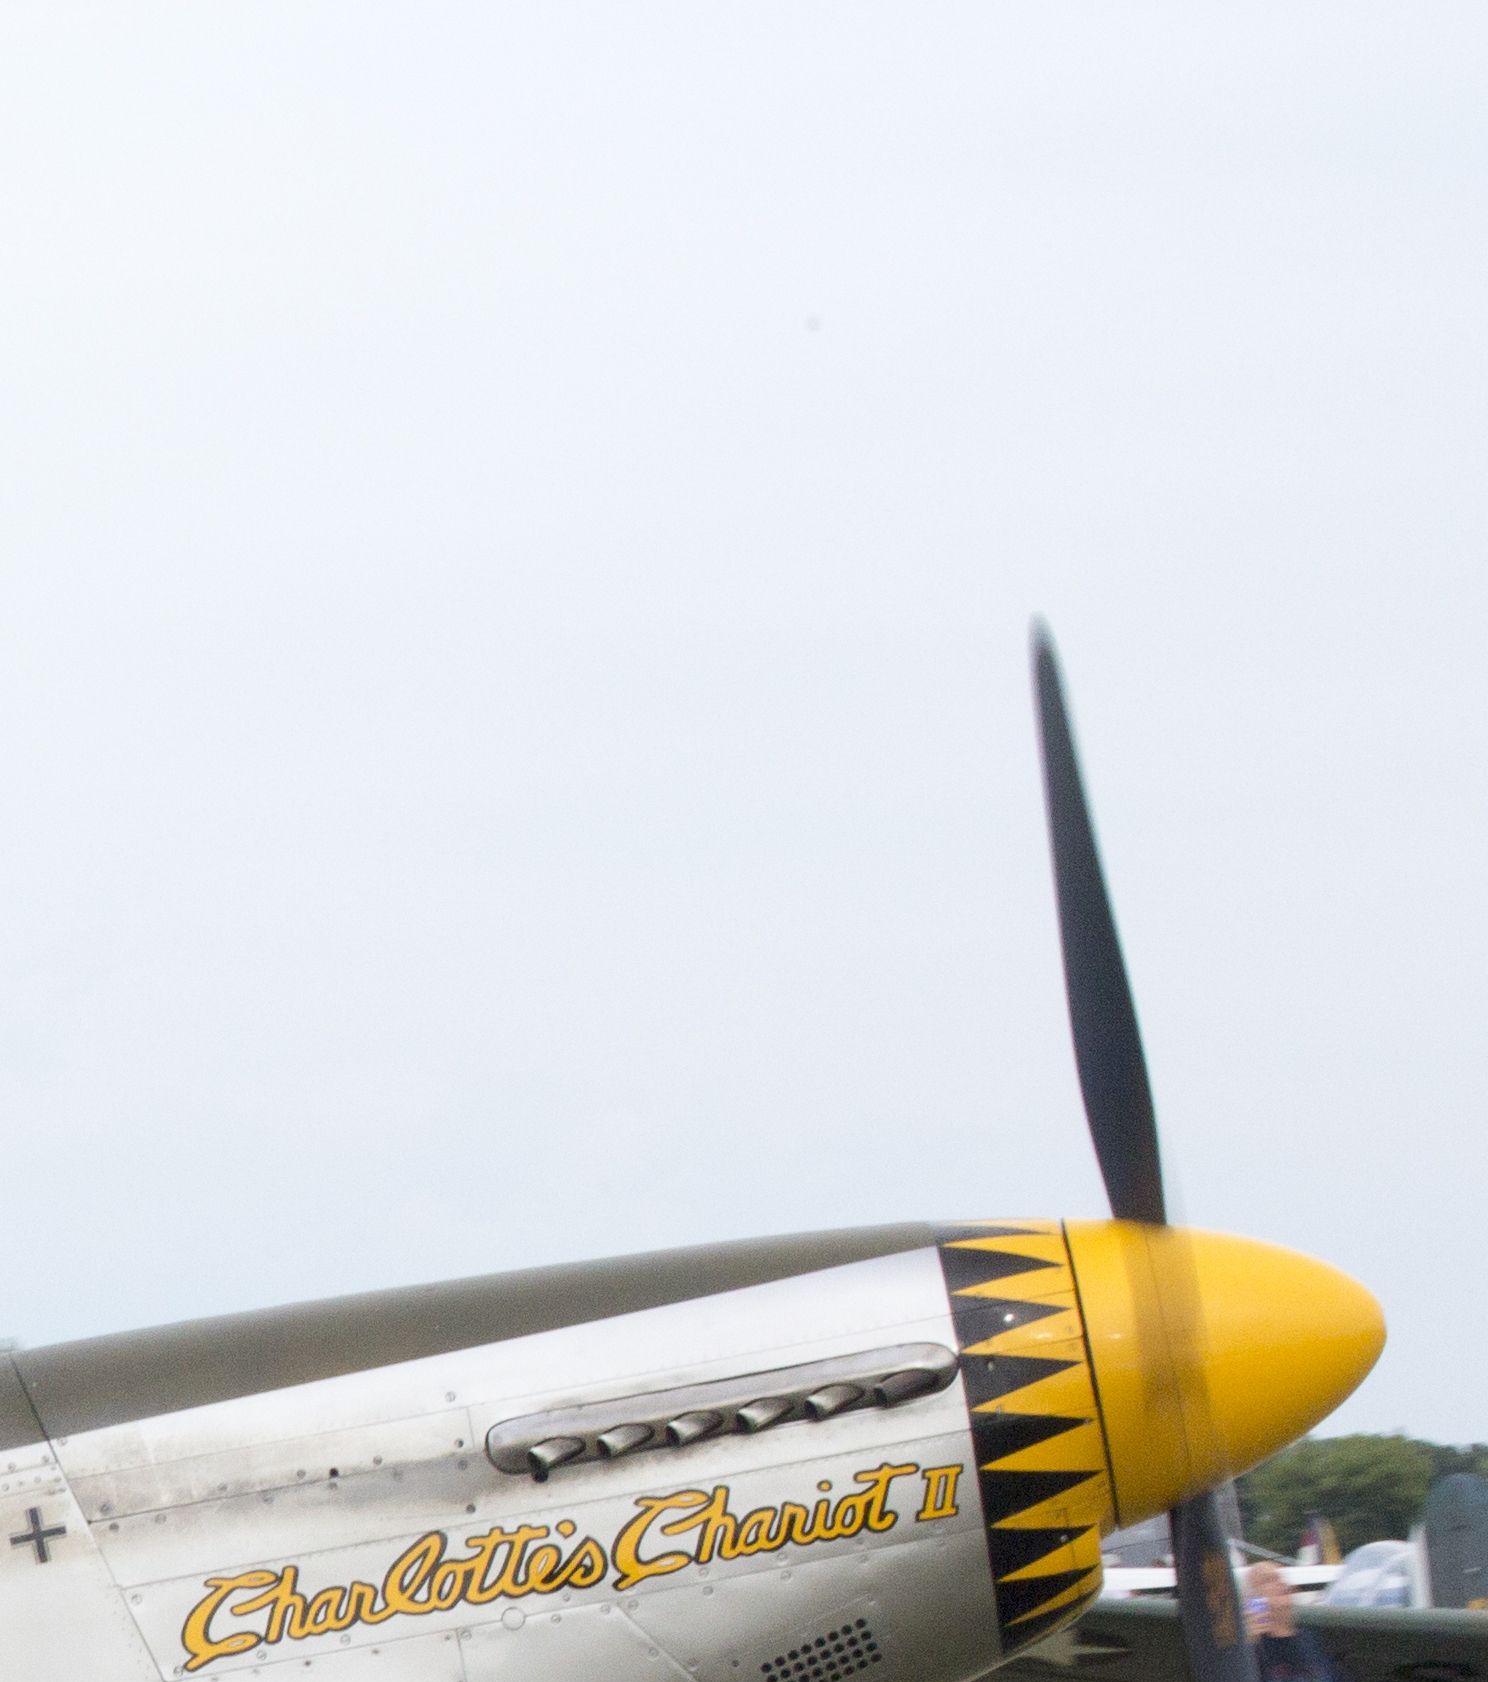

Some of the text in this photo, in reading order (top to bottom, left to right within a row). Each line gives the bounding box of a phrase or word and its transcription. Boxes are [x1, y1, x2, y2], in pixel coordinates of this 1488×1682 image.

[181, 1462, 964, 1673] Charlotte's Chariot II
